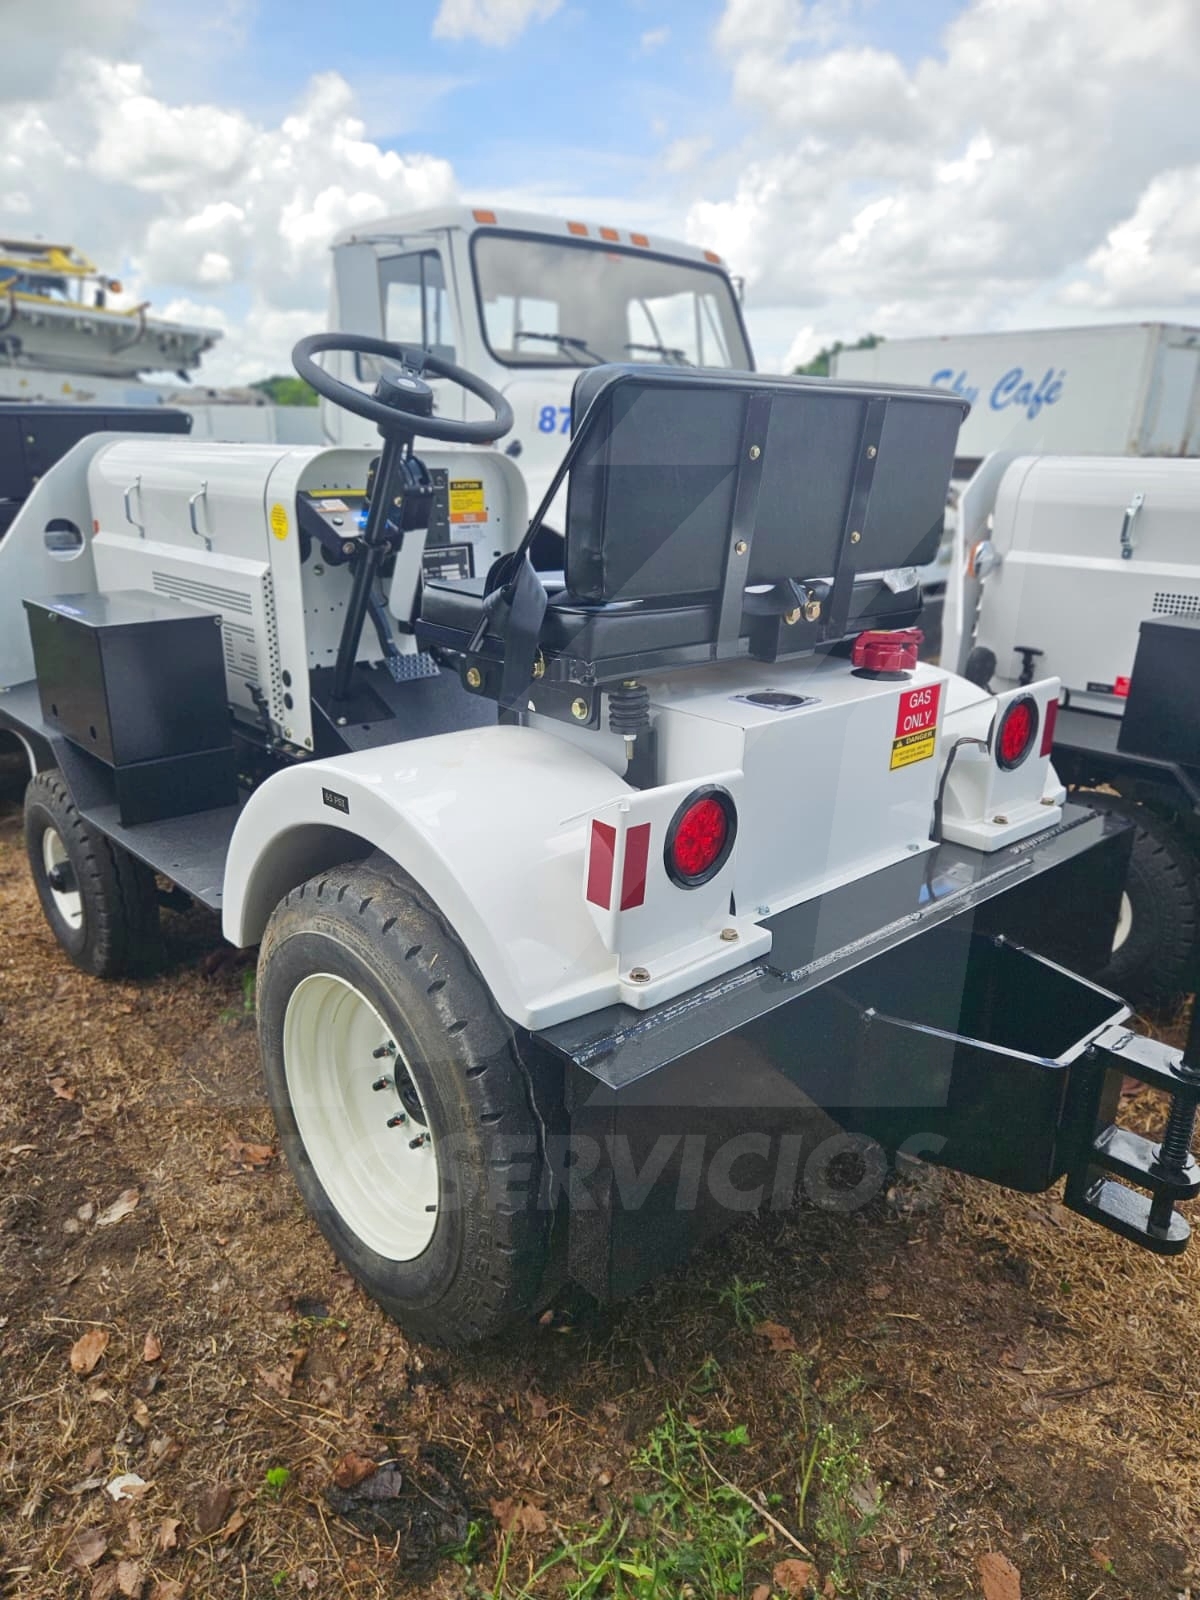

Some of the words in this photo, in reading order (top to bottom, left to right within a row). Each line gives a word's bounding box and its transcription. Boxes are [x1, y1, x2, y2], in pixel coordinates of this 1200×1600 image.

[989, 366, 1067, 420] Café
[909, 689, 932, 709] GAS
[903, 710, 932, 731] ONLY
[906, 730, 933, 745] DANGER
